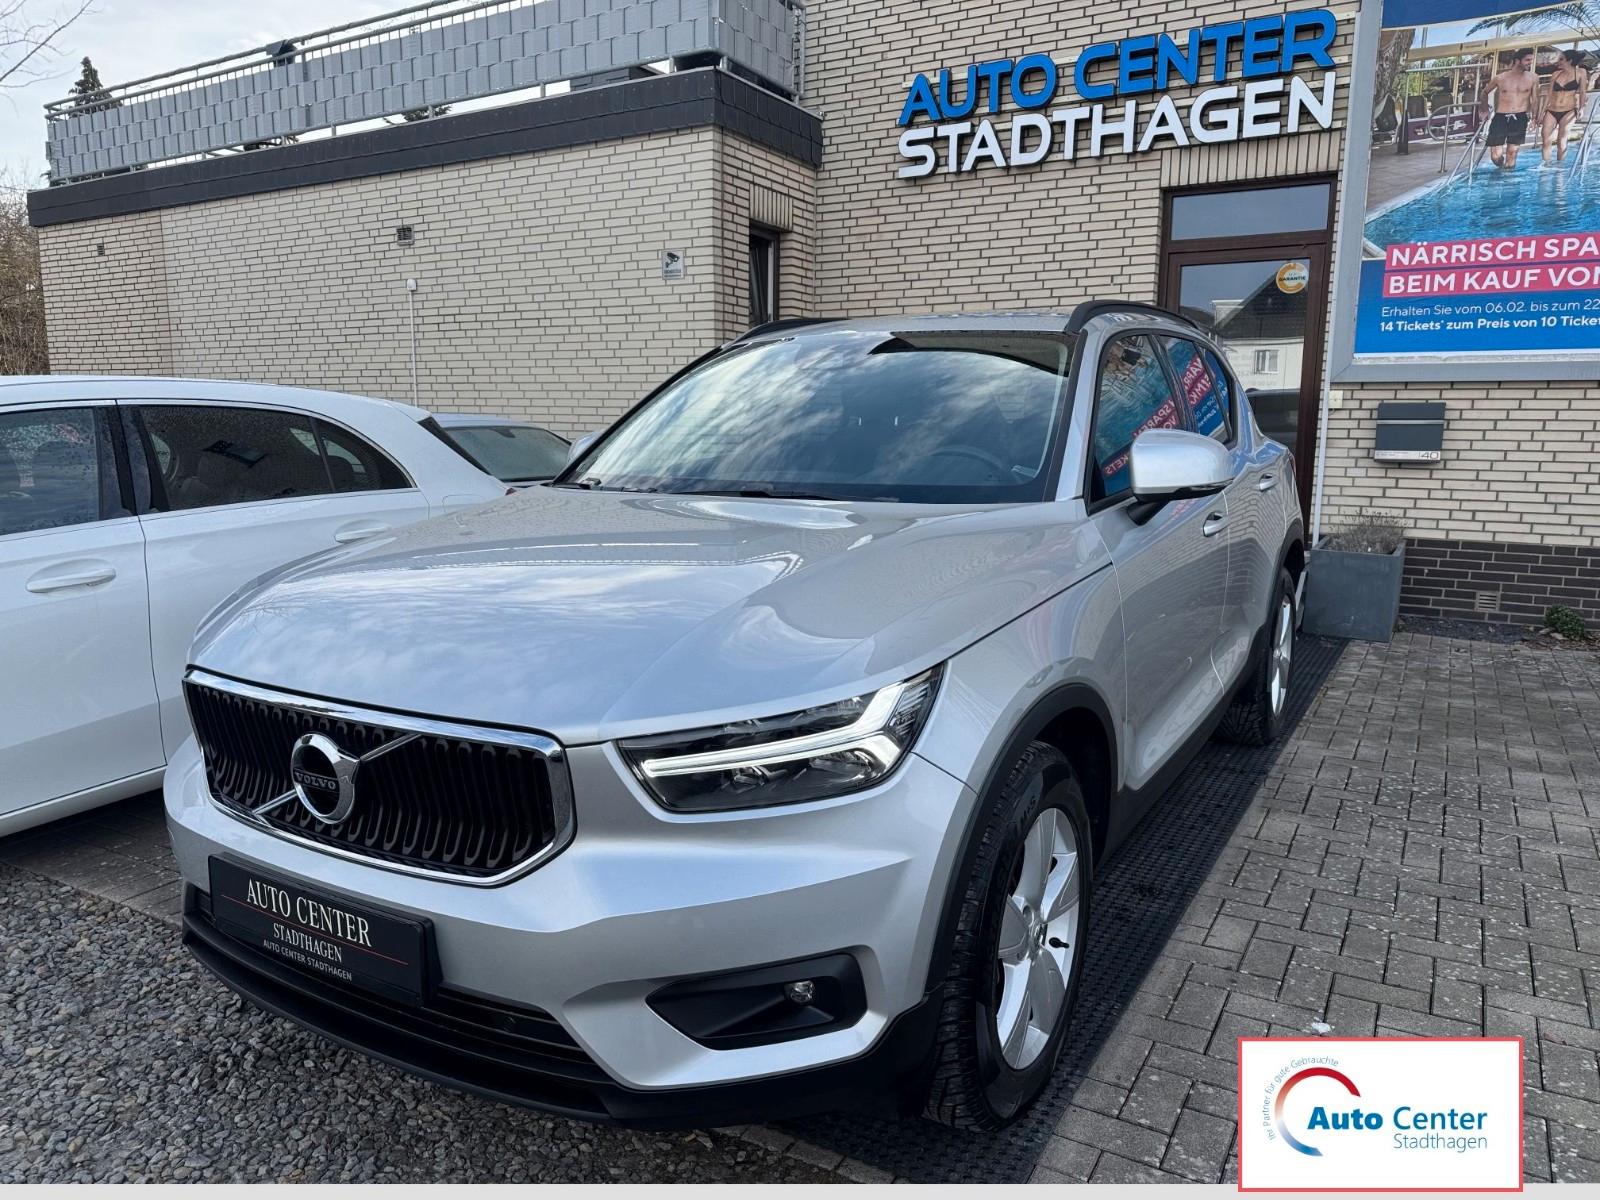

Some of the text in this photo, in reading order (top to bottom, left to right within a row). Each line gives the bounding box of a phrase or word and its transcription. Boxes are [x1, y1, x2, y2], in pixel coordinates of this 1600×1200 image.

[899, 9, 1337, 126] AUTO CENTER
[898, 71, 1337, 179] STADTHAGEN
[1391, 236, 1600, 266] NÄRRISCH SPA
[1388, 273, 1455, 294] BEIM
[1463, 269, 1541, 290] KAUF
[1380, 322, 1394, 332] 14
[1446, 320, 1473, 330] zum
[1477, 318, 1510, 329] Preis
[1513, 318, 1537, 328] von
[1541, 316, 1557, 327] 10
[1382, 306, 1430, 317] Erhalten
[1433, 305, 1452, 315] Sie
[1455, 306, 1481, 315] vom
[1485, 302, 1527, 313] 06.02.
[1530, 301, 1549, 312] bis
[1551, 302, 1580, 311] zum
[294, 772, 336, 790] VOLVO
[247, 878, 372, 947] AUTO CENTER
[273, 922, 342, 962] STADTHAGEN
[263, 939, 352, 981] AUTO CENTER STADTHAGEN
